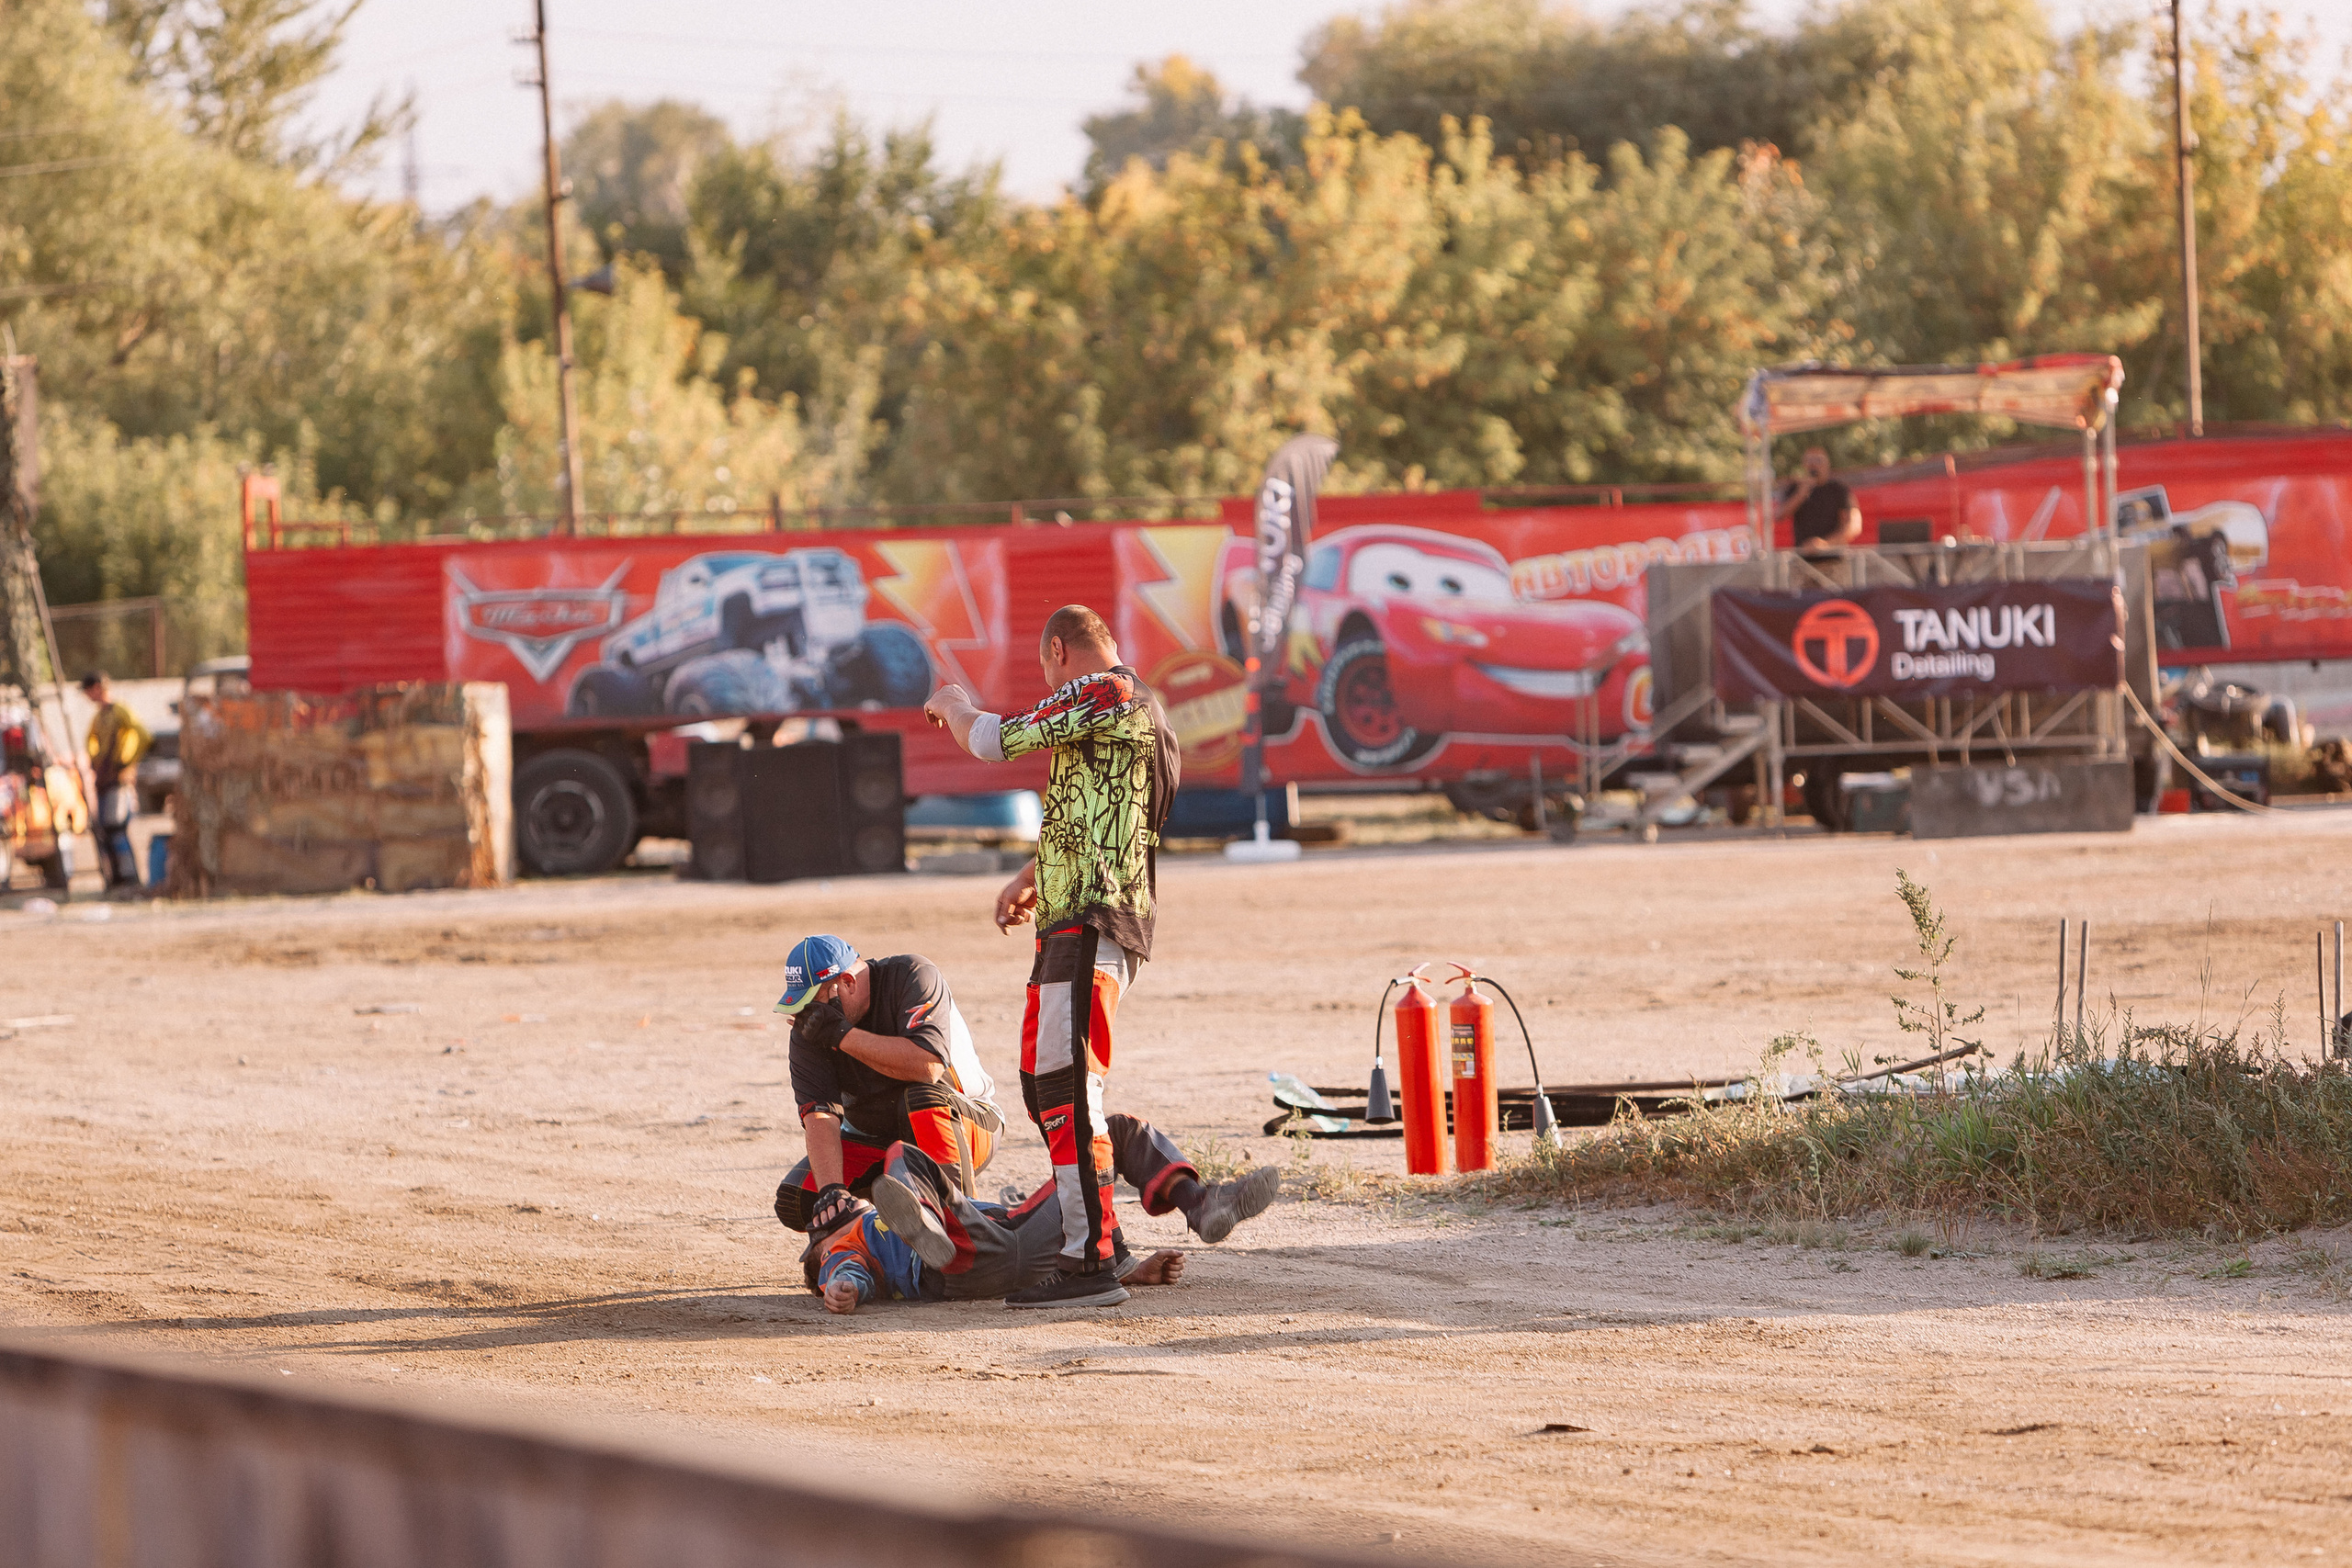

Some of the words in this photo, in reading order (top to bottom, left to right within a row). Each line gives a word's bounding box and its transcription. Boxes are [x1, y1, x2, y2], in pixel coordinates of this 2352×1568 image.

[1892, 604, 2056, 652] TANUKI
[1891, 650, 1996, 682] Detailing
[1044, 1115, 1067, 1131] SPORT
